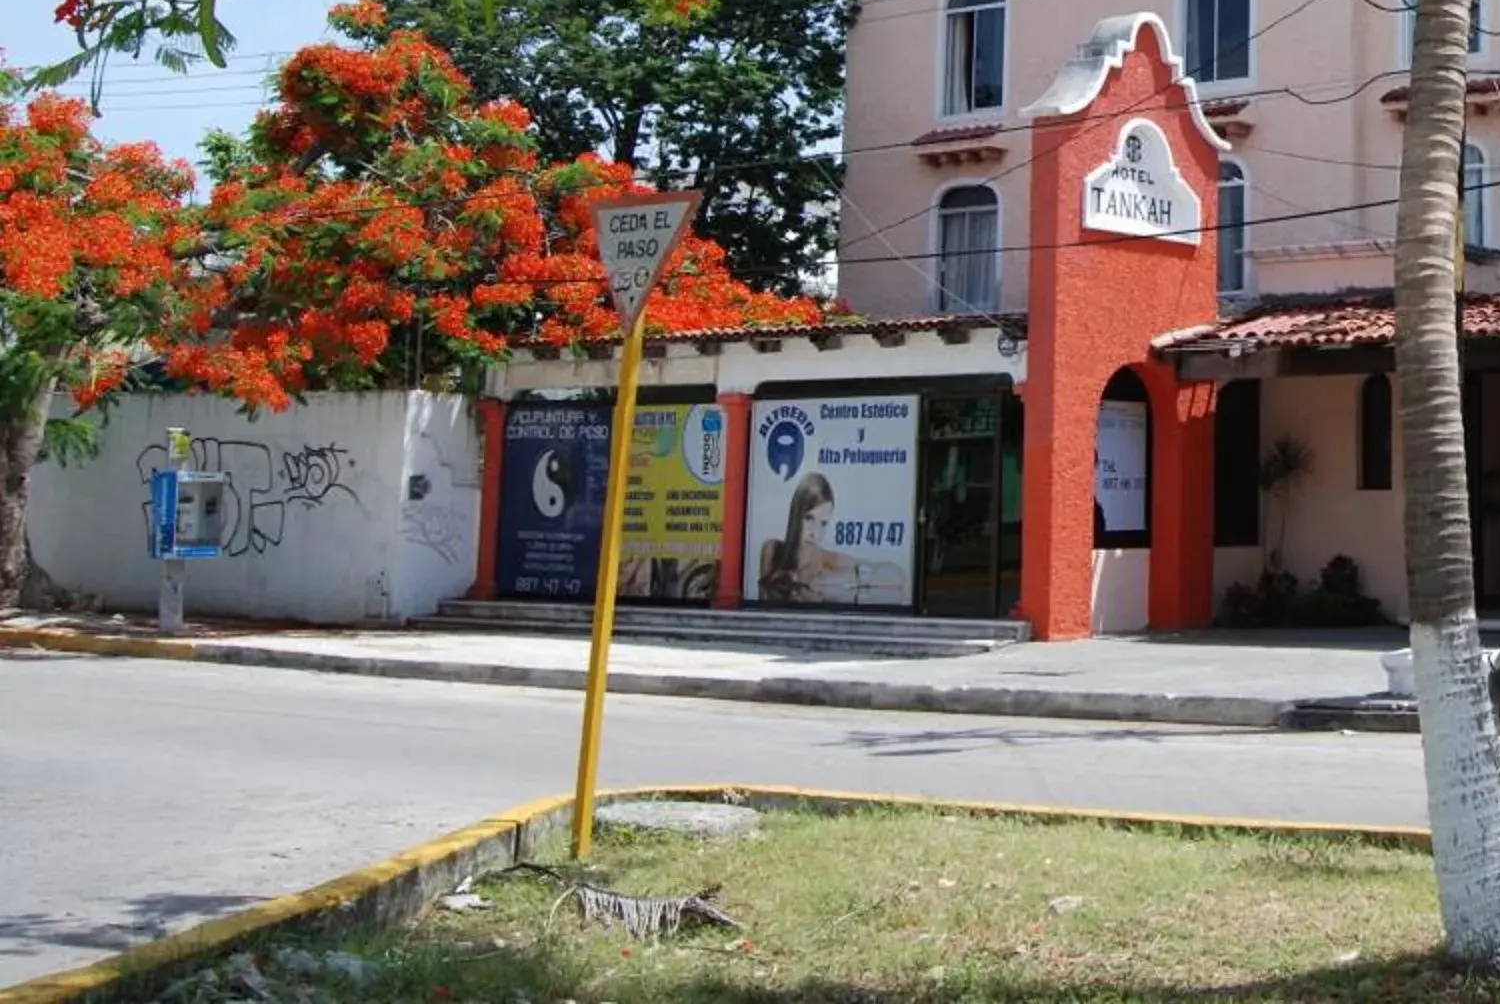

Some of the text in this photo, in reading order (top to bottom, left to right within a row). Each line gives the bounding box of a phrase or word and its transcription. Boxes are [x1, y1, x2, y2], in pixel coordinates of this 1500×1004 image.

[1111, 167, 1155, 185] HOTEL
[1092, 187, 1171, 225] TANKAH
[609, 211, 672, 233] CEDA EL
[616, 238, 659, 259] PASO
[512, 410, 585, 424] ACUPUNTURA
[759, 405, 815, 436] ALFREDO
[820, 403, 859, 420] Centro
[506, 425, 555, 439] CONTROL
[579, 425, 609, 439] PESO
[818, 447, 841, 464] Alta
[835, 521, 905, 546] 887 47 47
[515, 577, 582, 596] 887 47 47
